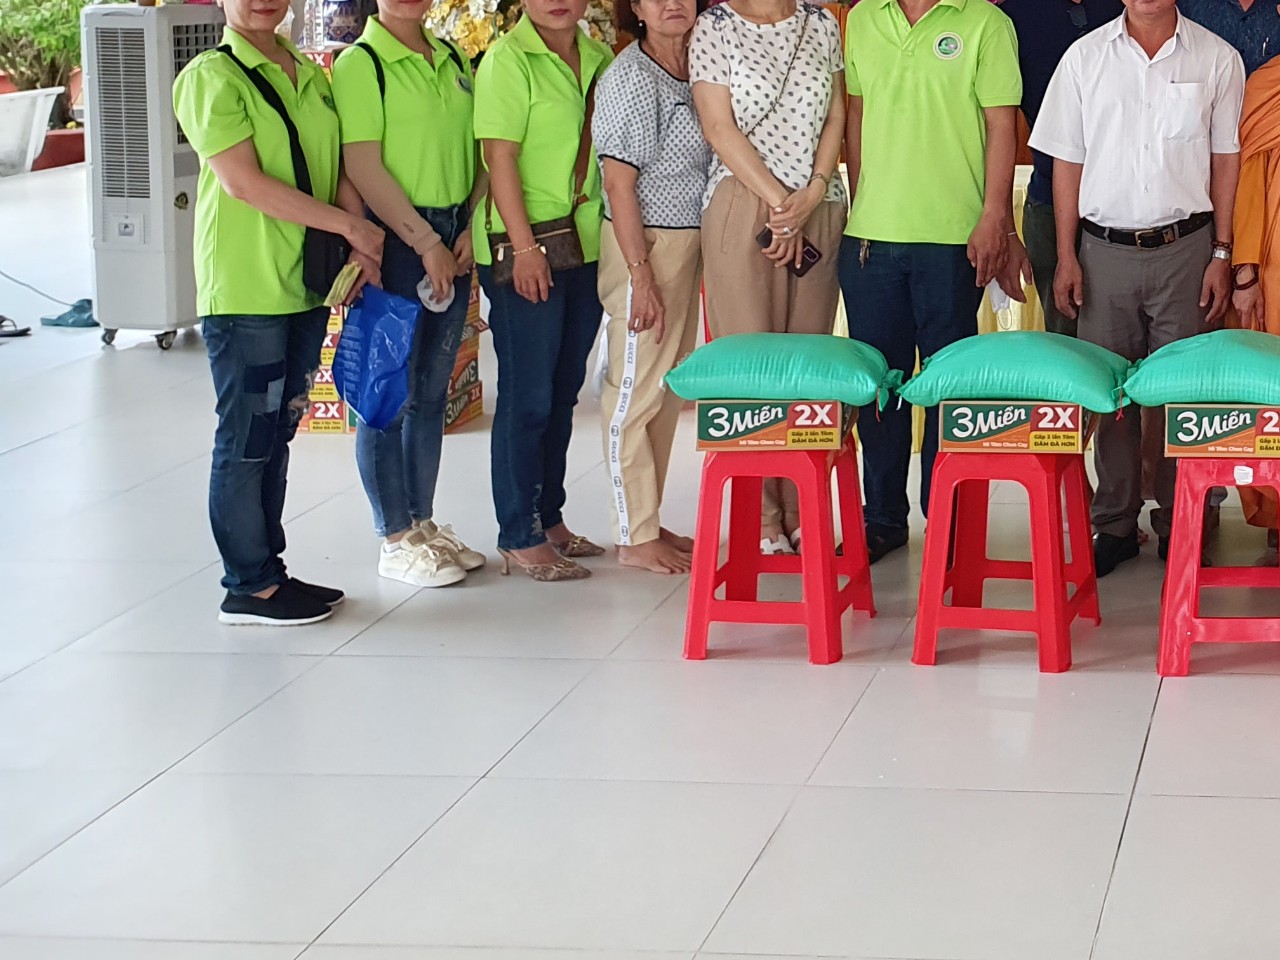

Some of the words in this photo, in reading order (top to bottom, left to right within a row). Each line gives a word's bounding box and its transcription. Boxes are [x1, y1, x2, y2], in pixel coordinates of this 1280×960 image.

[314, 403, 341, 418] 2X
[794, 404, 833, 426] 2X
[1037, 406, 1075, 429] 2X
